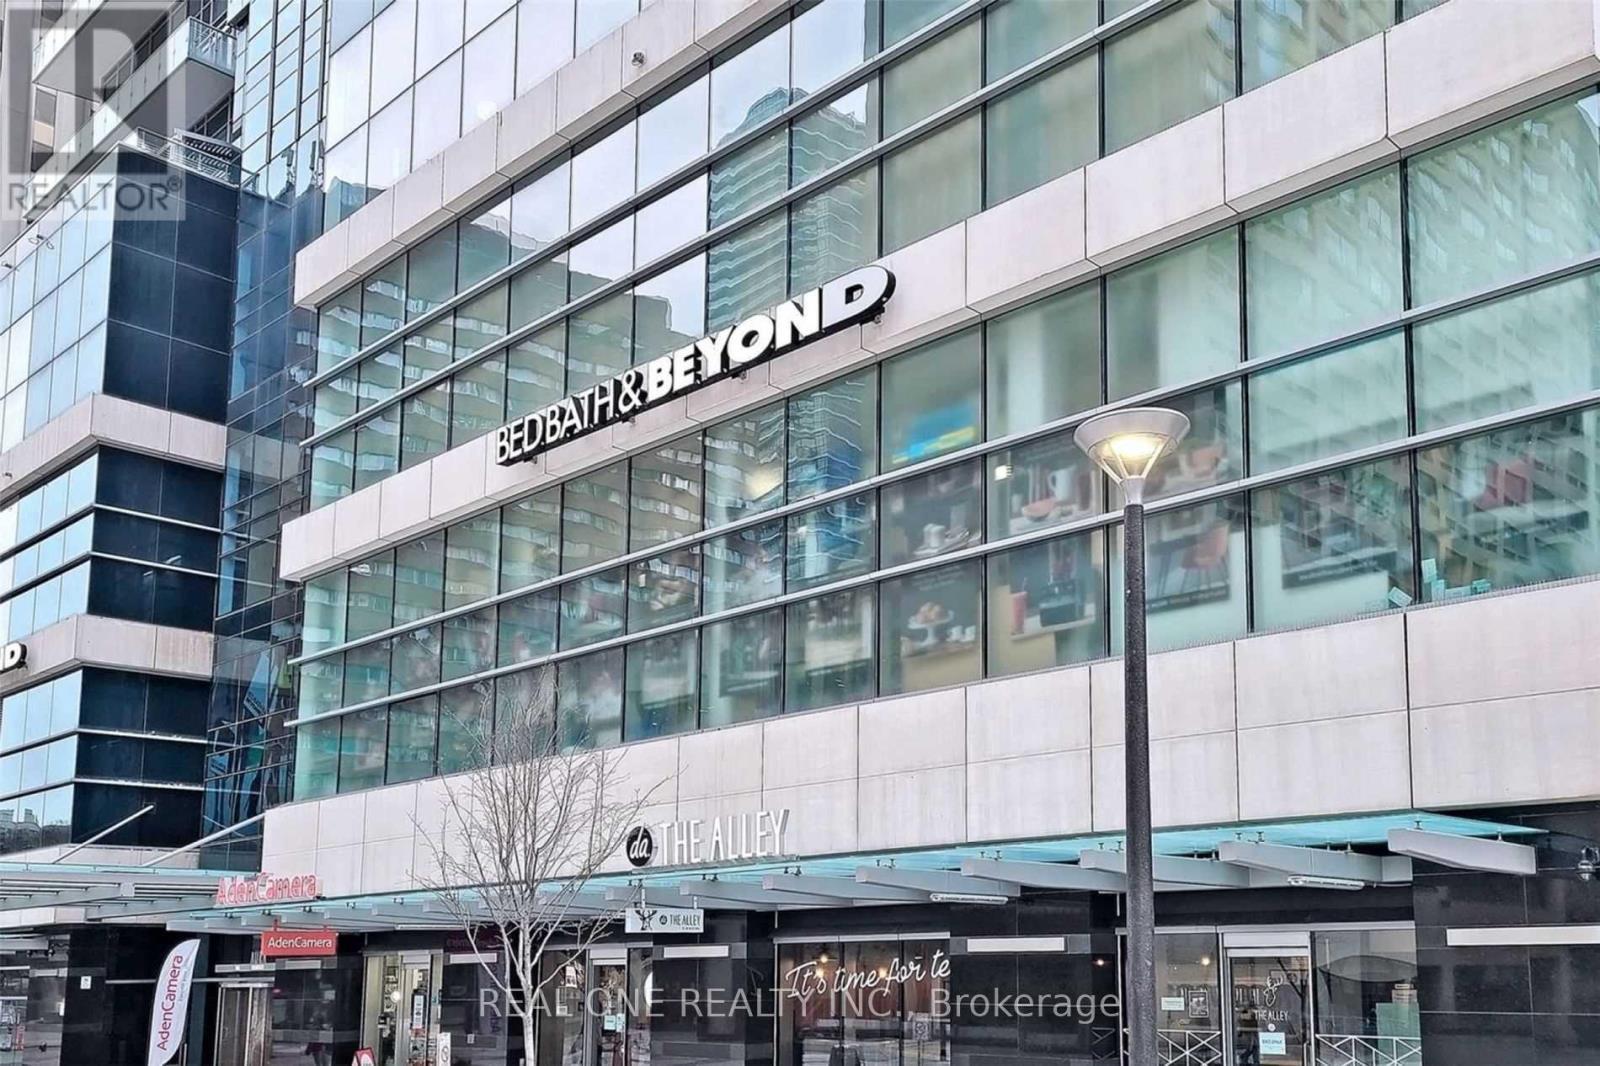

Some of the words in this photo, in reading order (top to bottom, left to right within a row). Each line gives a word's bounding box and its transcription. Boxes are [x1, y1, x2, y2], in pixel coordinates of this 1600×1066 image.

[495, 409, 545, 466] BED
[545, 376, 617, 443] BATH
[617, 369, 645, 412] &
[647, 265, 895, 404] BEYOND
[0, 640, 27, 672] D
[660, 820, 705, 866] THE
[709, 808, 790, 861] ALLEY
[216, 872, 317, 905] AdenCamera
[670, 914, 681, 926] THE
[682, 914, 701, 926] ALLEY
[267, 936, 332, 949] AdenCamera
[785, 960, 827, 998] It's
[833, 966, 880, 992] time
[883, 957, 926, 997] for
[157, 955, 184, 1051] AdenCamera
[1253, 1009, 1267, 1021] THE
[1268, 1009, 1289, 1021] ALLEY
